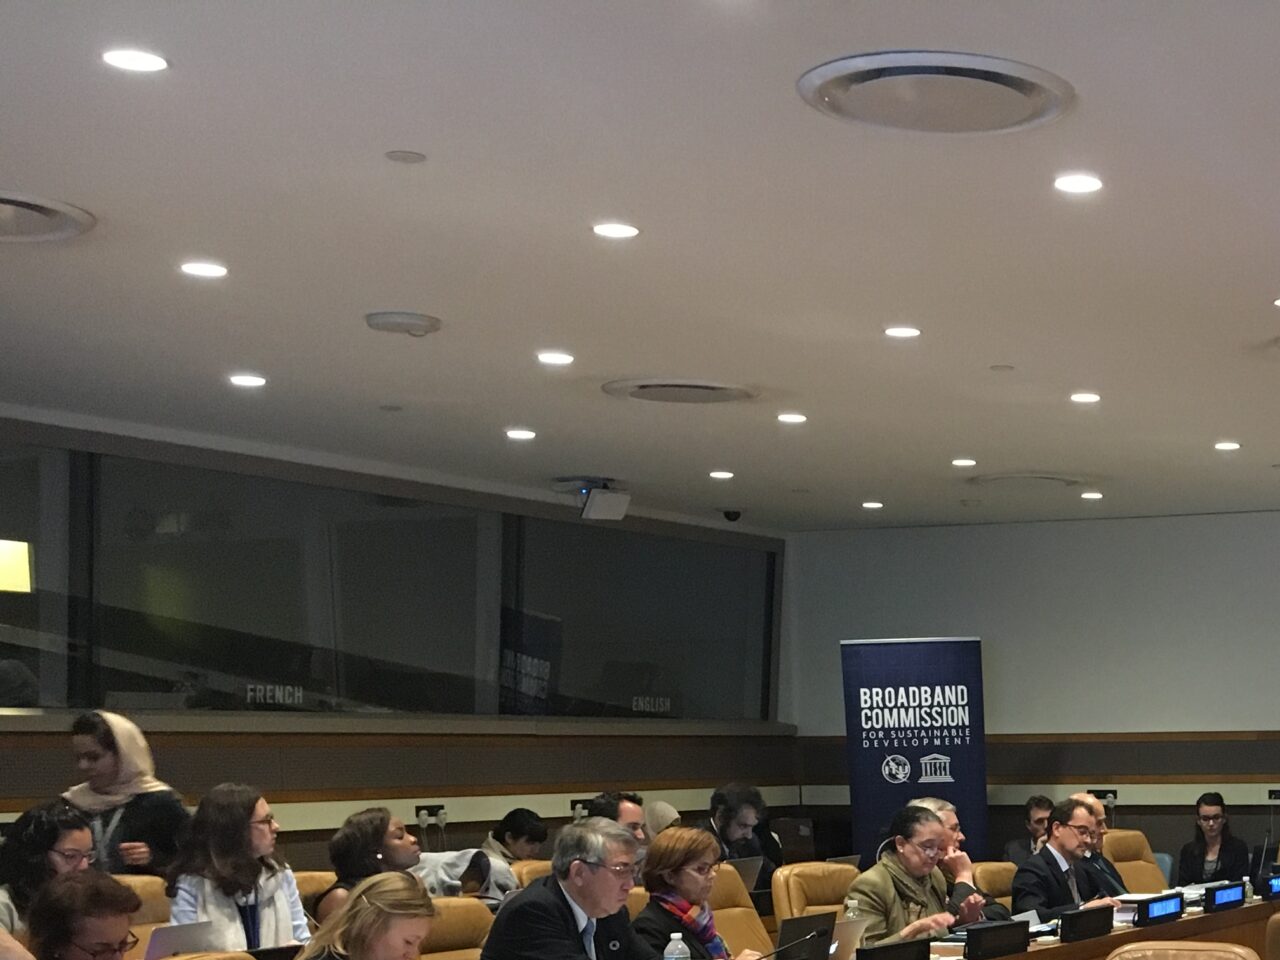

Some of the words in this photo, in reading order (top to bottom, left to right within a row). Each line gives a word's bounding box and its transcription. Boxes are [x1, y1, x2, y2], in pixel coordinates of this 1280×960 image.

[246, 684, 303, 704] FRENCH
[859, 685, 968, 708] BROADBAND
[632, 696, 671, 712] ENGLISH
[861, 706, 970, 729] COMMISSION
[862, 730, 884, 739] FOR
[890, 728, 971, 738] SUSTAINABLE
[862, 737, 971, 748] DEVELOPMENT
